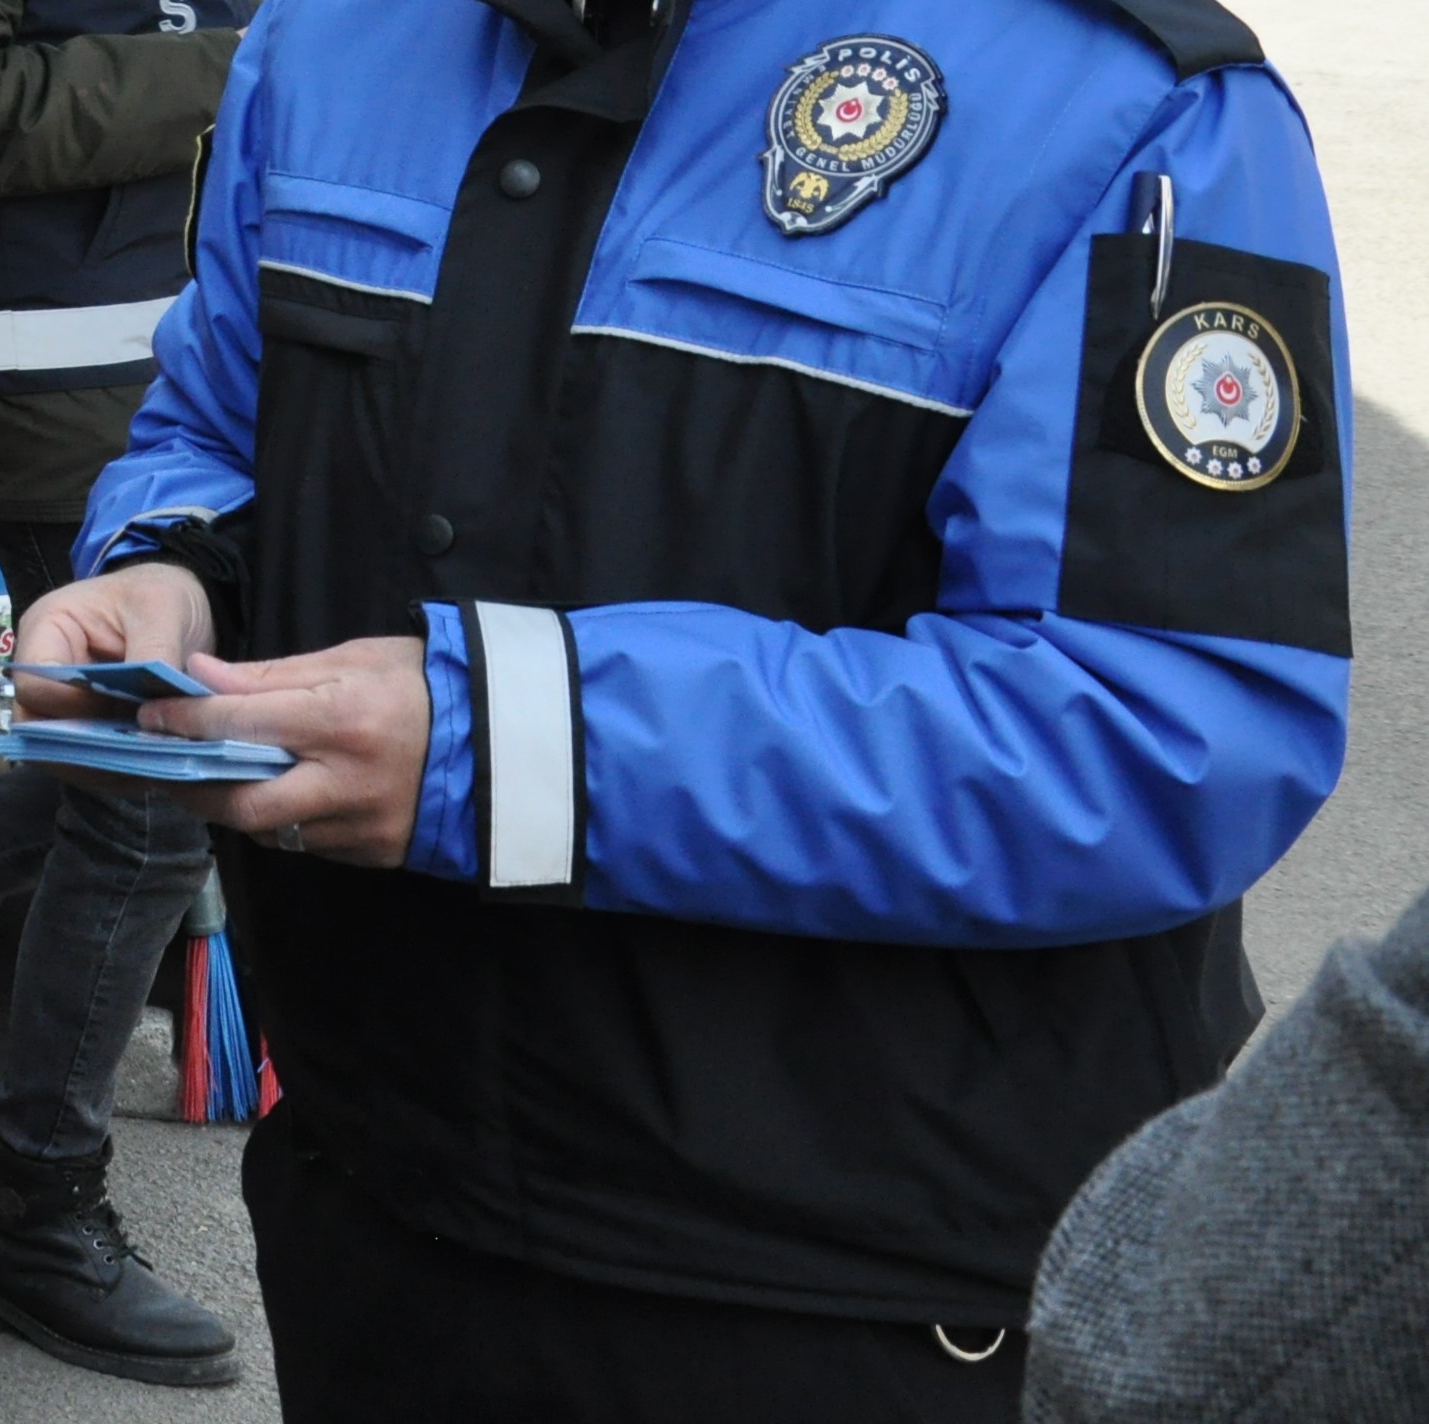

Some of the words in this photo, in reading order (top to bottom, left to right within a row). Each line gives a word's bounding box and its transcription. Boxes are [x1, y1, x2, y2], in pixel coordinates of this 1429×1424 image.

[838, 46, 922, 84] POLİS
[795, 145, 851, 173] GENEL
[1193, 311, 1261, 340] KARS
[1211, 444, 1239, 458] EGM
